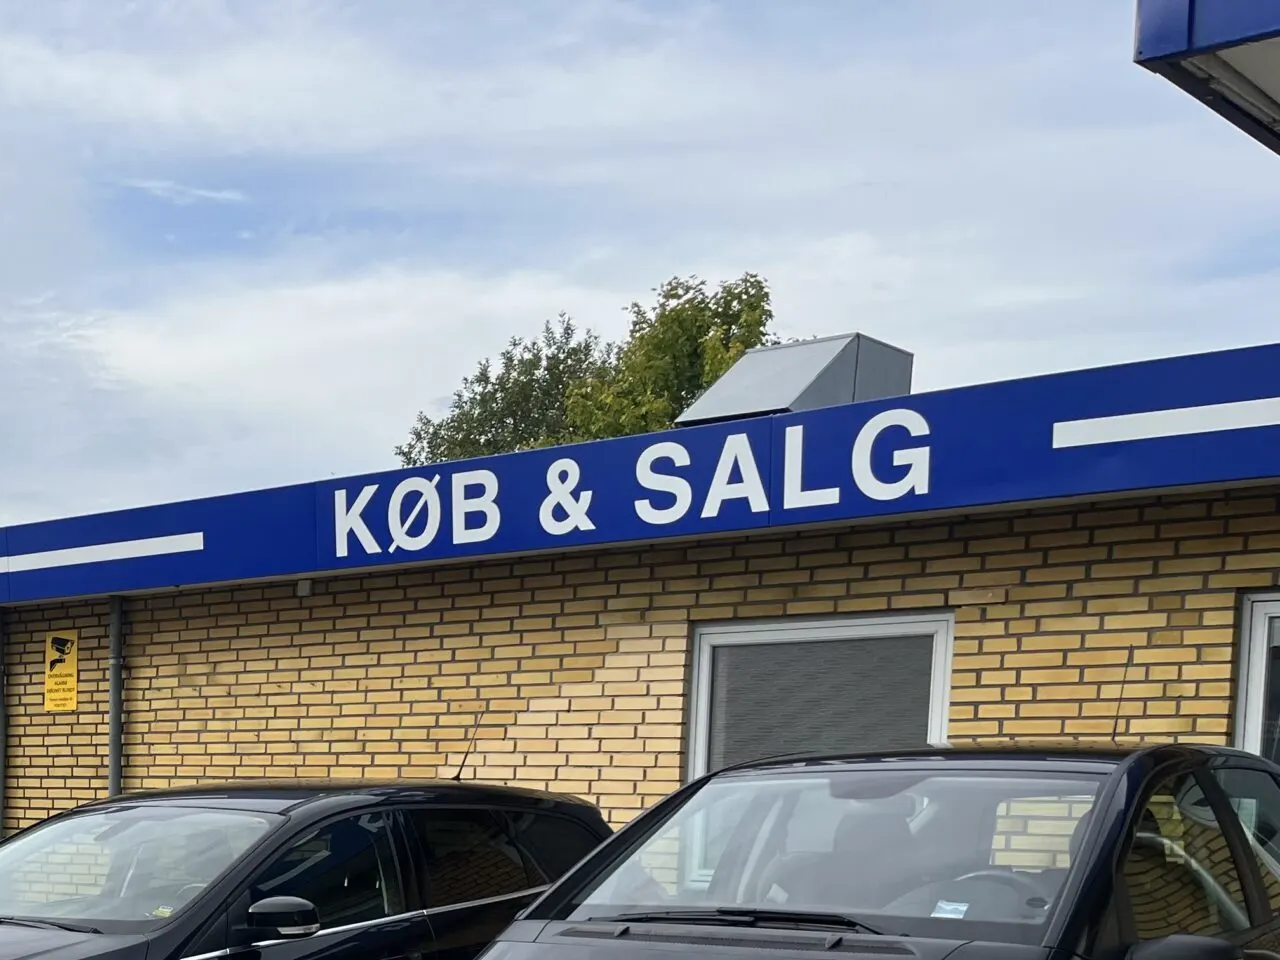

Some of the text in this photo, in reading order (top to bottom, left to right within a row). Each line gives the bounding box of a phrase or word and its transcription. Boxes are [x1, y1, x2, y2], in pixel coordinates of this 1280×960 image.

[334, 408, 931, 557] KØB & SALG
